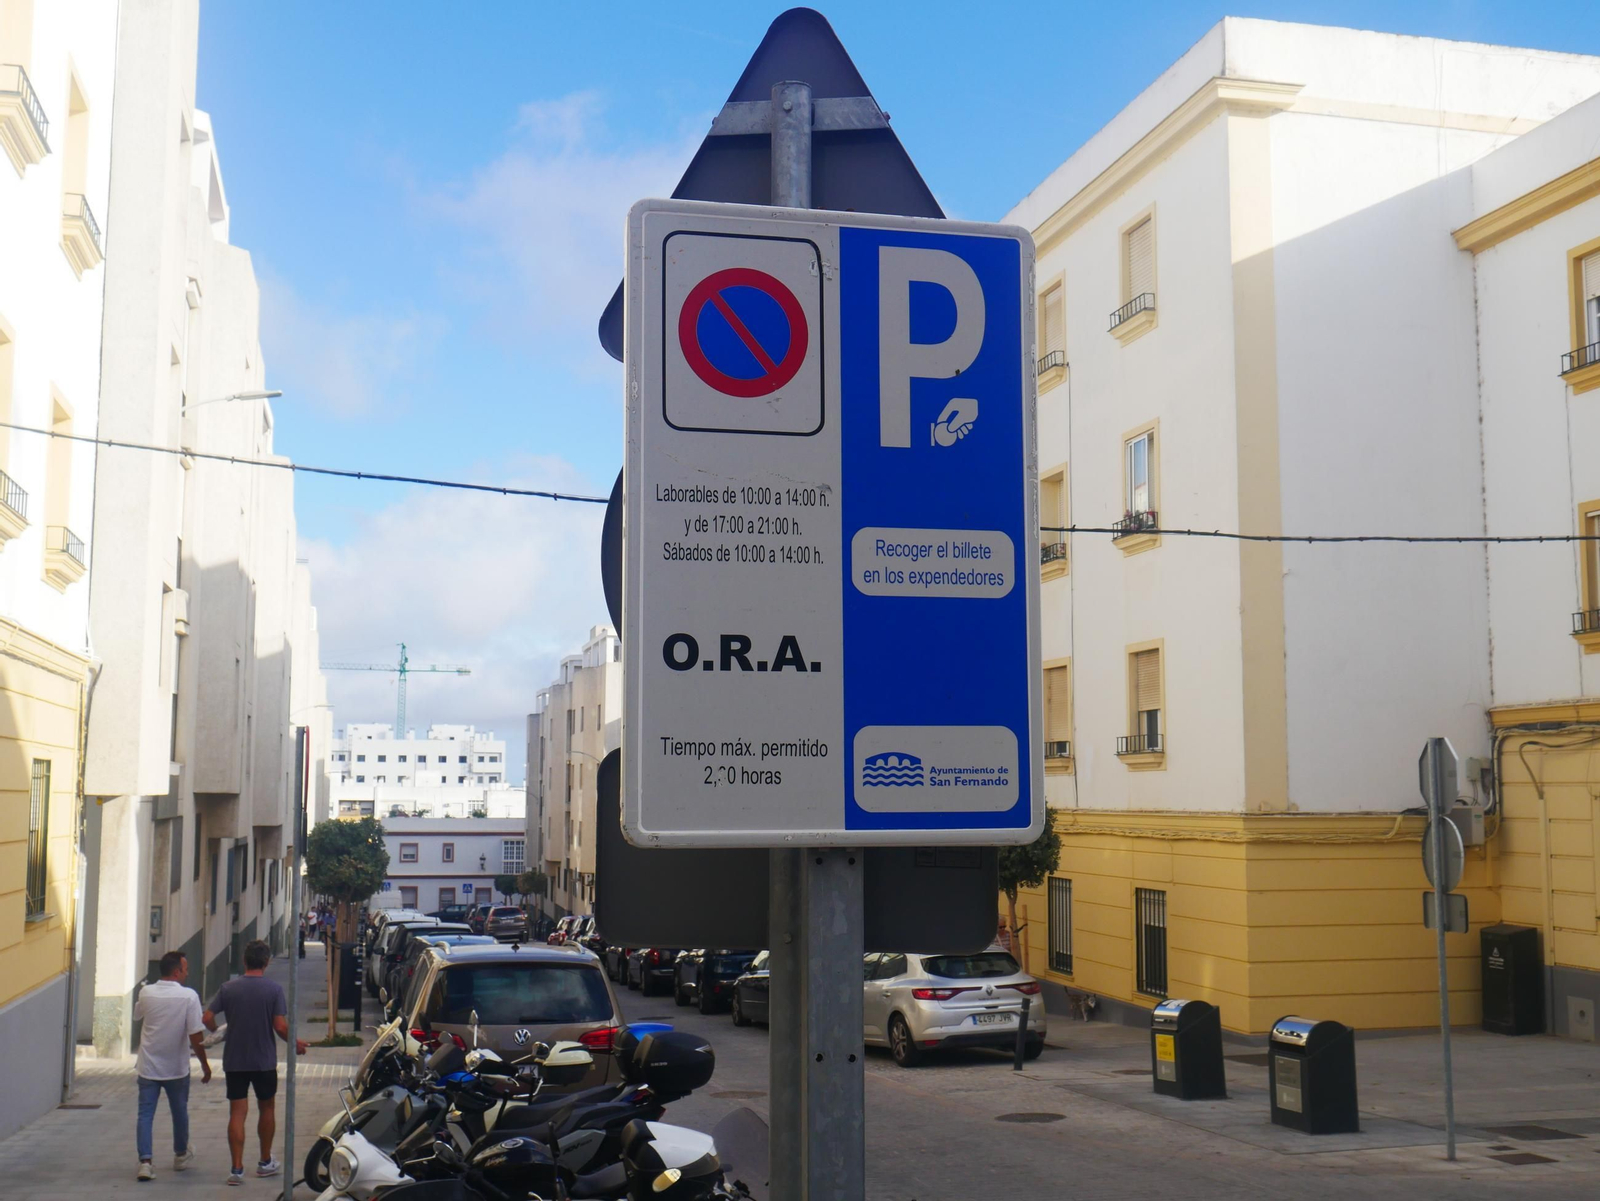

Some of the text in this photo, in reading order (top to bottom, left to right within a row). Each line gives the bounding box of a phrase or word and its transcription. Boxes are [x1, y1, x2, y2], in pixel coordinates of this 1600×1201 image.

[879, 245, 986, 448] P
[656, 484, 831, 507] Laborables de 10:00 a 14:00 h.
[684, 515, 802, 537] y de 17:00 a 21:00 h.
[663, 542, 824, 564] Sábados de 10:00 a 14:00 h.
[875, 539, 991, 562] Recoger el billete
[863, 567, 1004, 588] en los expendedores
[662, 633, 822, 673] O.R.A.
[660, 737, 828, 761] Tiempo máx. permitido
[741, 766, 782, 785] horas
[930, 766, 1009, 776] Ayuntamiento de
[930, 776, 1009, 786] San Fernando
